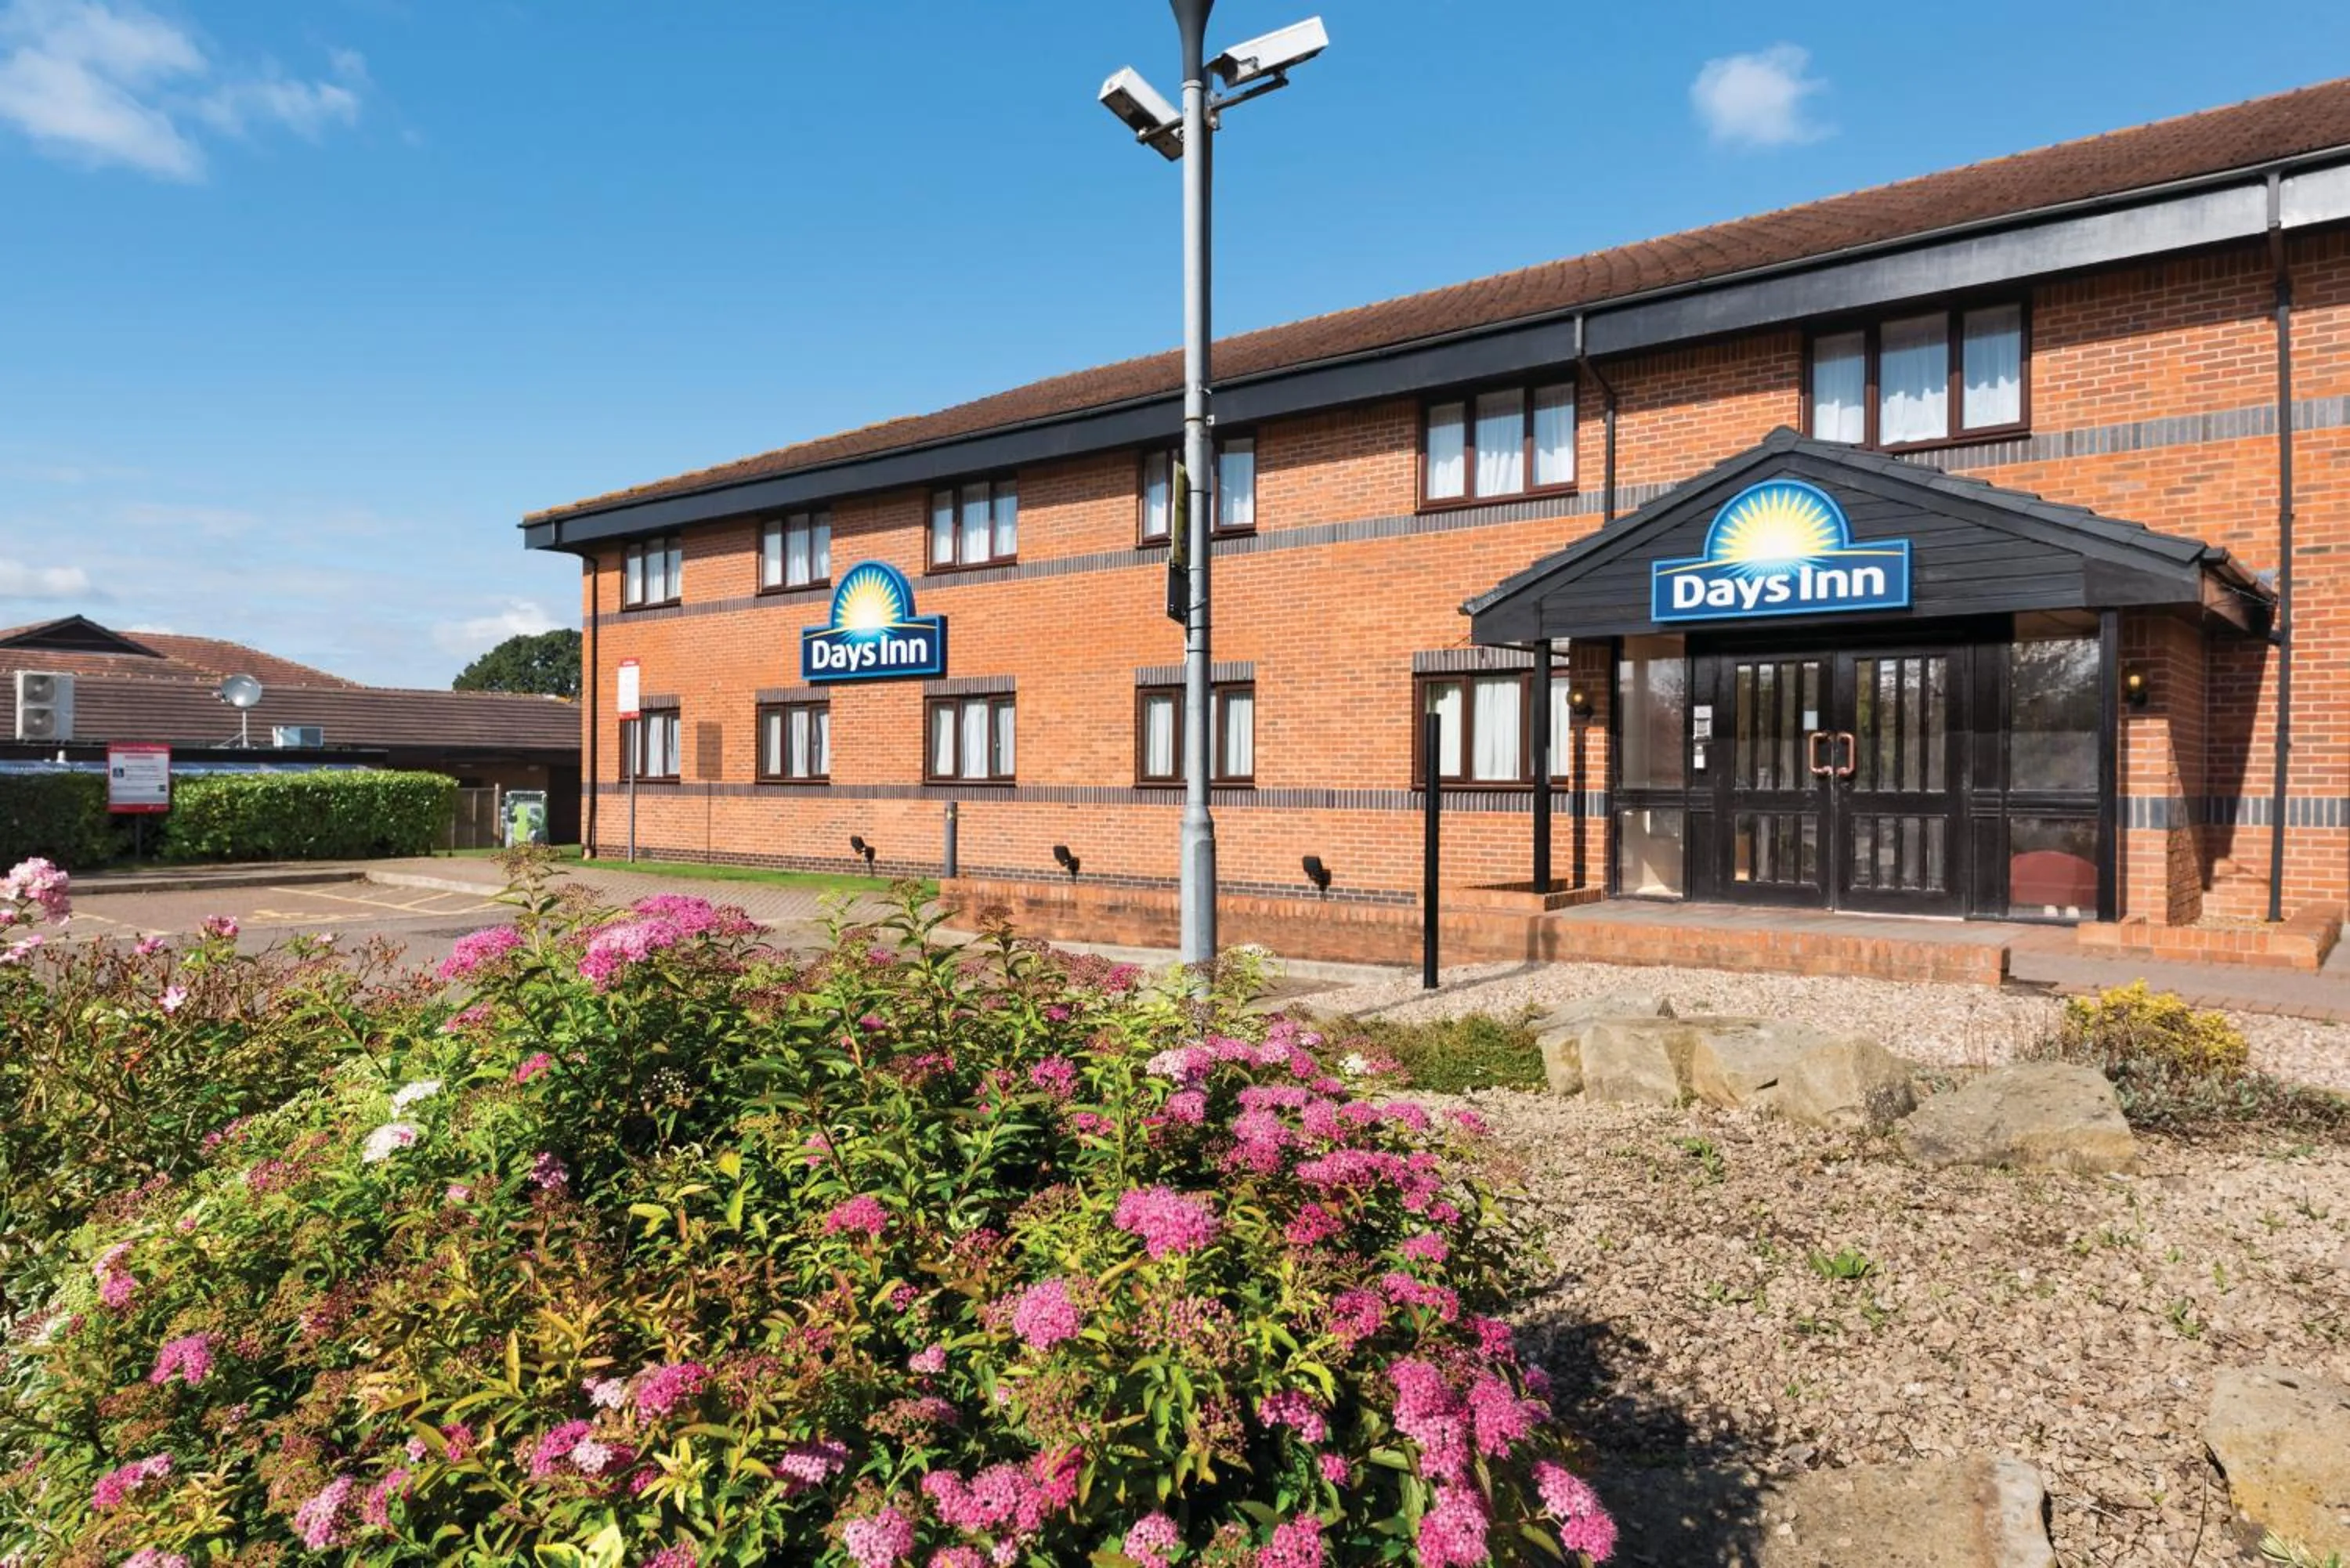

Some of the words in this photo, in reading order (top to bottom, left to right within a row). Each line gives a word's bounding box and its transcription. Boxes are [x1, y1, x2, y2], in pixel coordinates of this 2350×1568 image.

[1673, 573, 1791, 609] Days
[1799, 566, 1885, 601] Inn
[812, 640, 877, 671] Days
[880, 634, 927, 665] Inn
